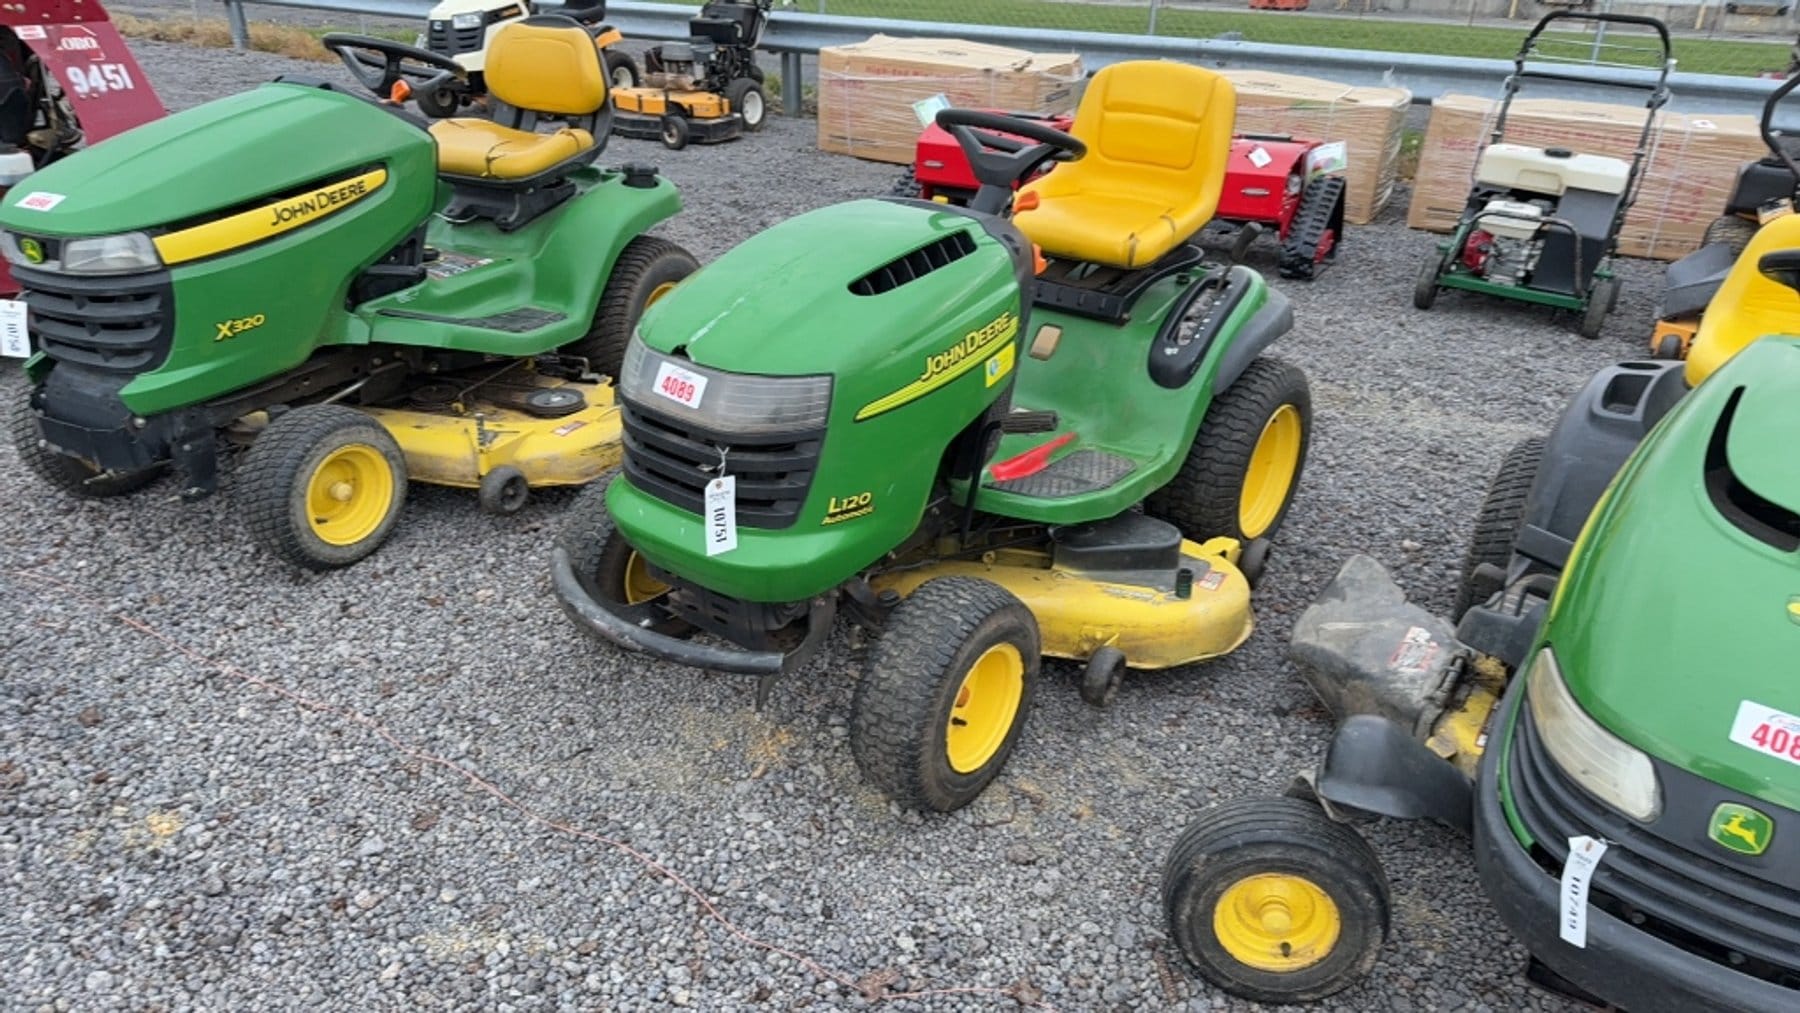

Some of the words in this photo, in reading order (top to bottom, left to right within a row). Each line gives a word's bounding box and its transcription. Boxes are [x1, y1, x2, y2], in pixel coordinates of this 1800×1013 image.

[271, 198, 317, 226] JOHN
[315, 179, 367, 209] DEERE
[214, 313, 266, 341] X320
[921, 341, 966, 381] JOHN
[965, 311, 1011, 354] DEERE
[661, 375, 695, 402] 4089
[820, 505, 874, 526] Automatic
[828, 491, 872, 514] L120
[713, 506, 728, 543] 10751
